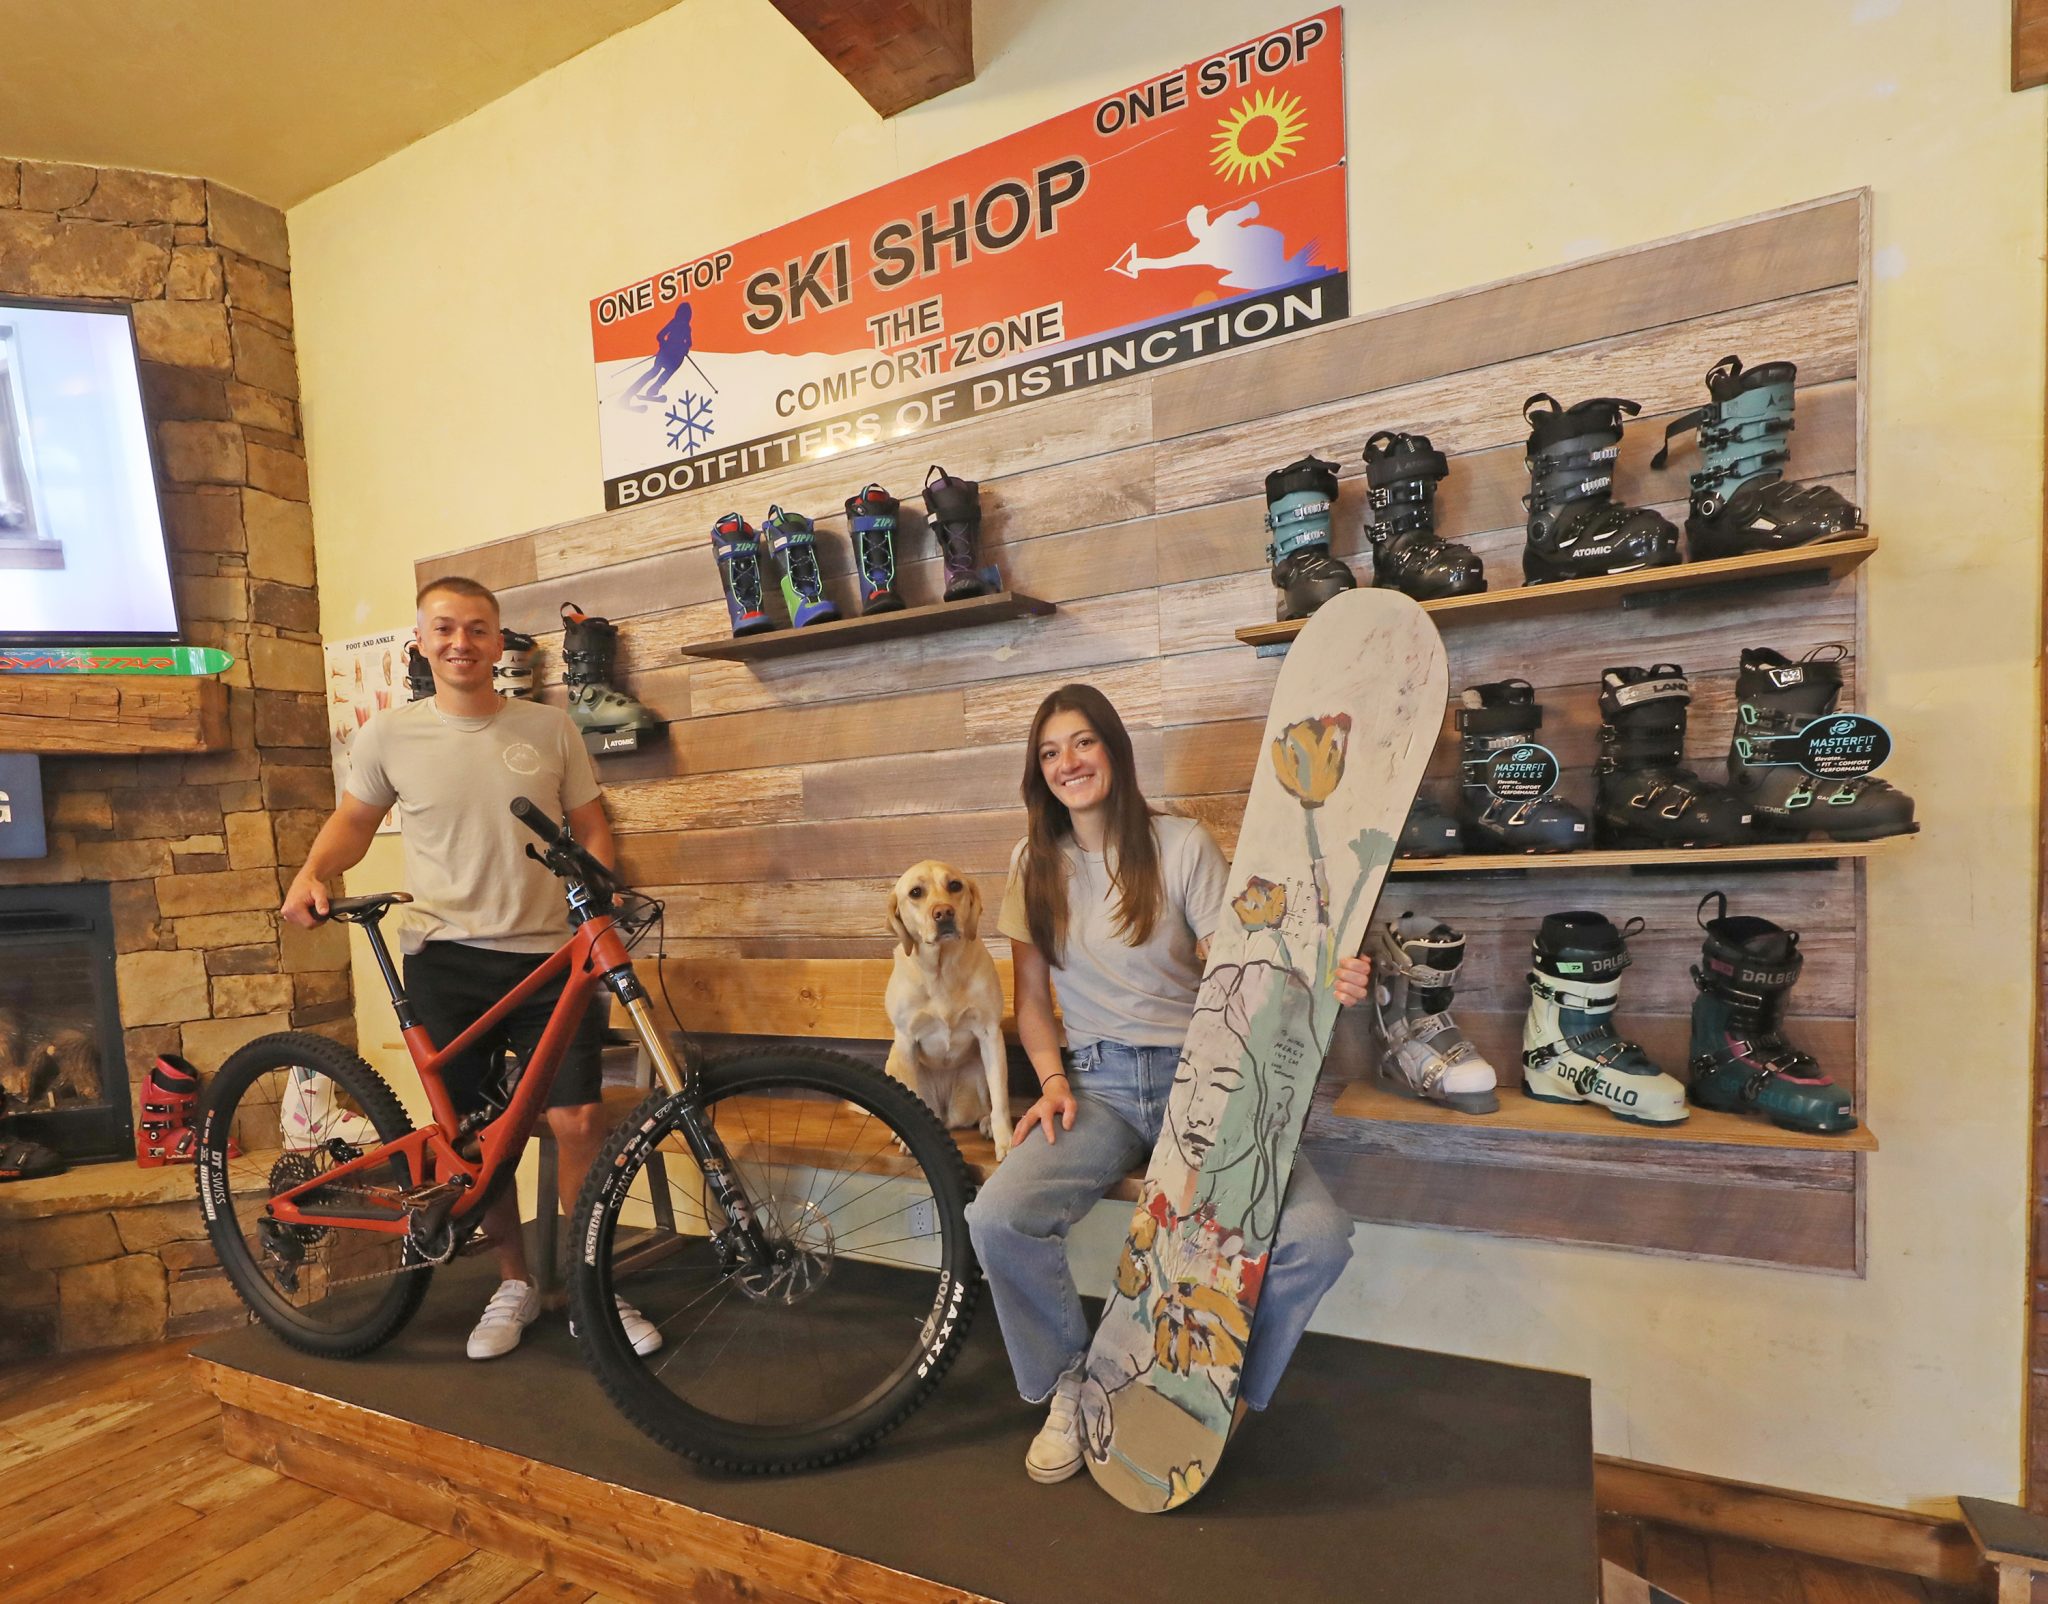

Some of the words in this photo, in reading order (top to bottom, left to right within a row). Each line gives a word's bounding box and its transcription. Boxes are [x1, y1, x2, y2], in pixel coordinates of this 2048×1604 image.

[1095, 72, 1187, 135] ONE
[1199, 21, 1324, 97] STOP
[745, 243, 850, 333] SKI
[871, 158, 1087, 288] SHOP
[599, 282, 653, 325] ONE
[659, 252, 733, 302] STOP
[869, 299, 941, 347] THE
[774, 342, 943, 419] COMFORT
[953, 306, 1061, 369] ZONE
[618, 412, 882, 505] BOOTFITTERS
[896, 390, 956, 430] OF
[973, 287, 1323, 412] DISTINCTION
[1572, 545, 1612, 558] ATOMIC
[346, 642, 361, 651] FOOT
[362, 639, 375, 648] AND
[375, 635, 396, 646] ANKLE
[610, 738, 635, 747] ATOMIC
[1808, 734, 1877, 748] MASTERFIT
[1808, 744, 1873, 756] INSOLES
[1492, 771, 1543, 779] INSOLES
[1494, 762, 1547, 772] MASTERFIT
[1819, 765, 1870, 773] PERFORMANCE
[1838, 759, 1872, 767] COMFORT
[1557, 1061, 1639, 1107] DAELLO
[211, 1150, 223, 1170] DT
[634, 1140, 654, 1167] DT
[211, 1171, 227, 1206] SWISS
[609, 1165, 636, 1211] SWISS
[917, 1280, 965, 1380] MAXXIS
